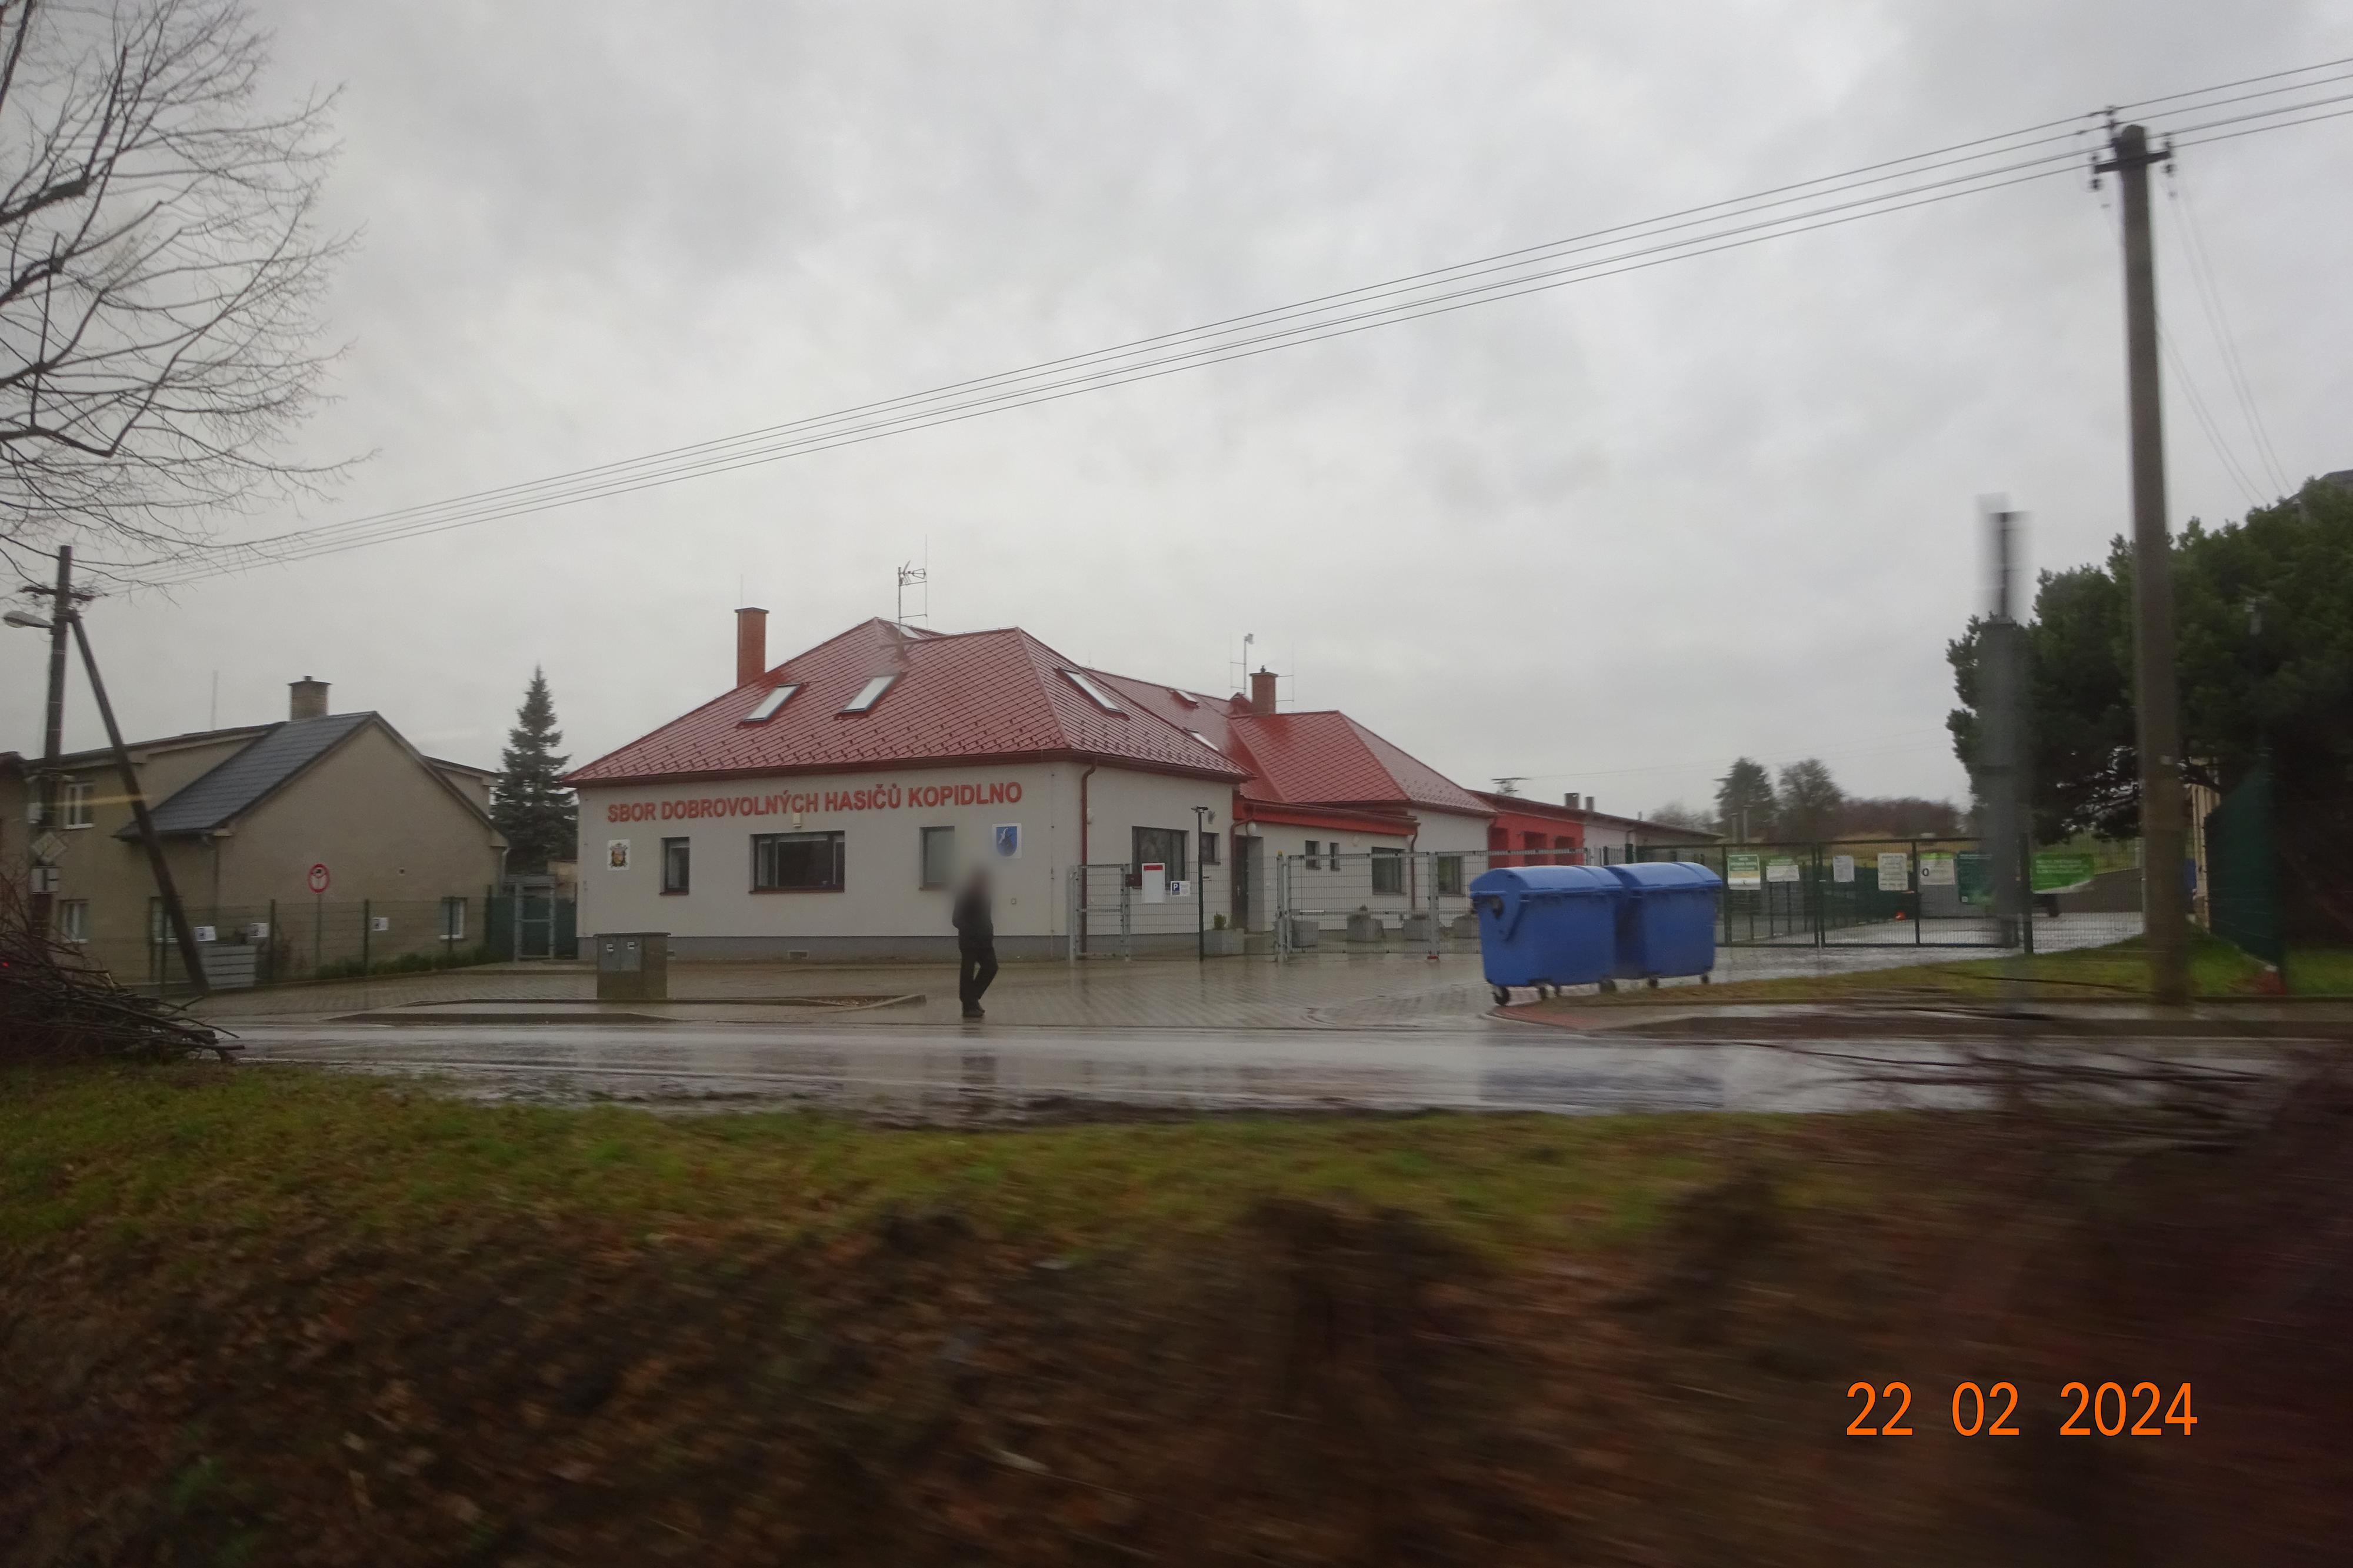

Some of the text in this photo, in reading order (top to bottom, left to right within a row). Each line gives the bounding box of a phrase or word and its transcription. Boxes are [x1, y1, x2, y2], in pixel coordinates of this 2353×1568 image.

[608, 782, 1022, 823] SBOR DOBROVOLNÝCH HASIČŮ KOPIDLNO
